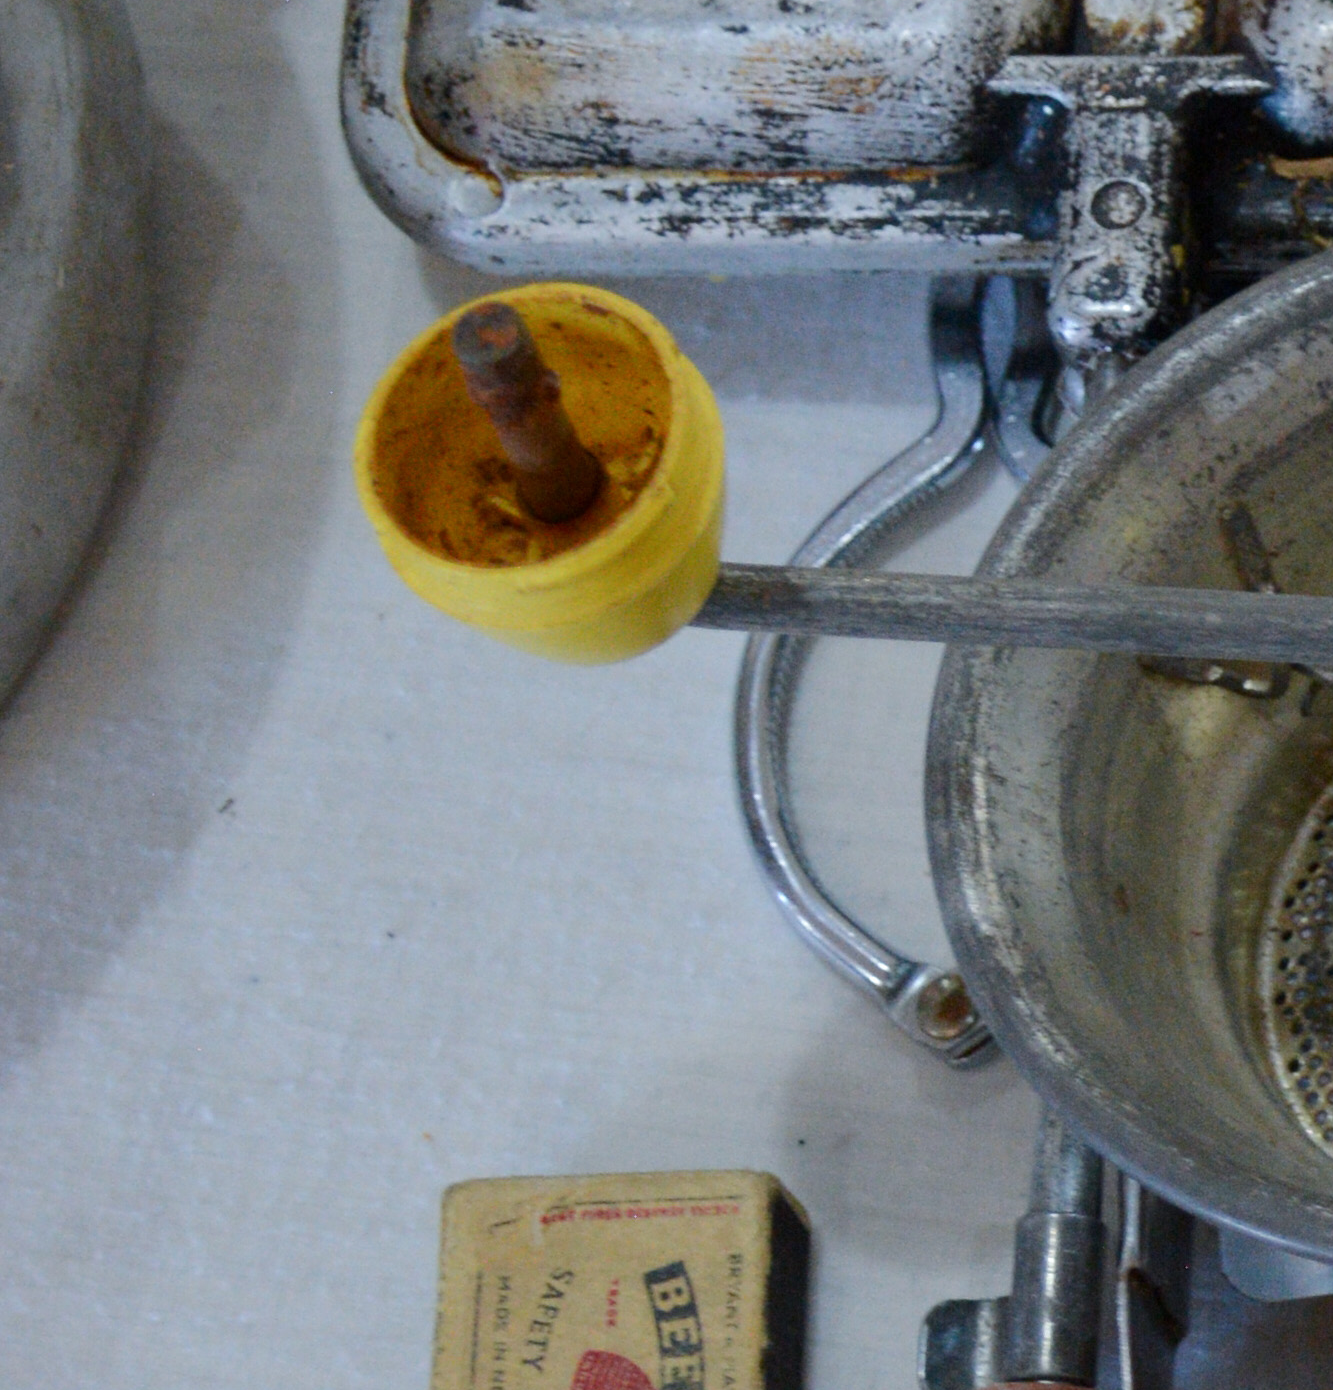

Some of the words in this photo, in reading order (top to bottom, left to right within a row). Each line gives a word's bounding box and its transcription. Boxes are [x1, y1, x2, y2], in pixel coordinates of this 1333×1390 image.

[493, 1275, 510, 1331] MADE
[522, 1269, 575, 1372] SAFETY
[492, 1341, 504, 1361] IN
